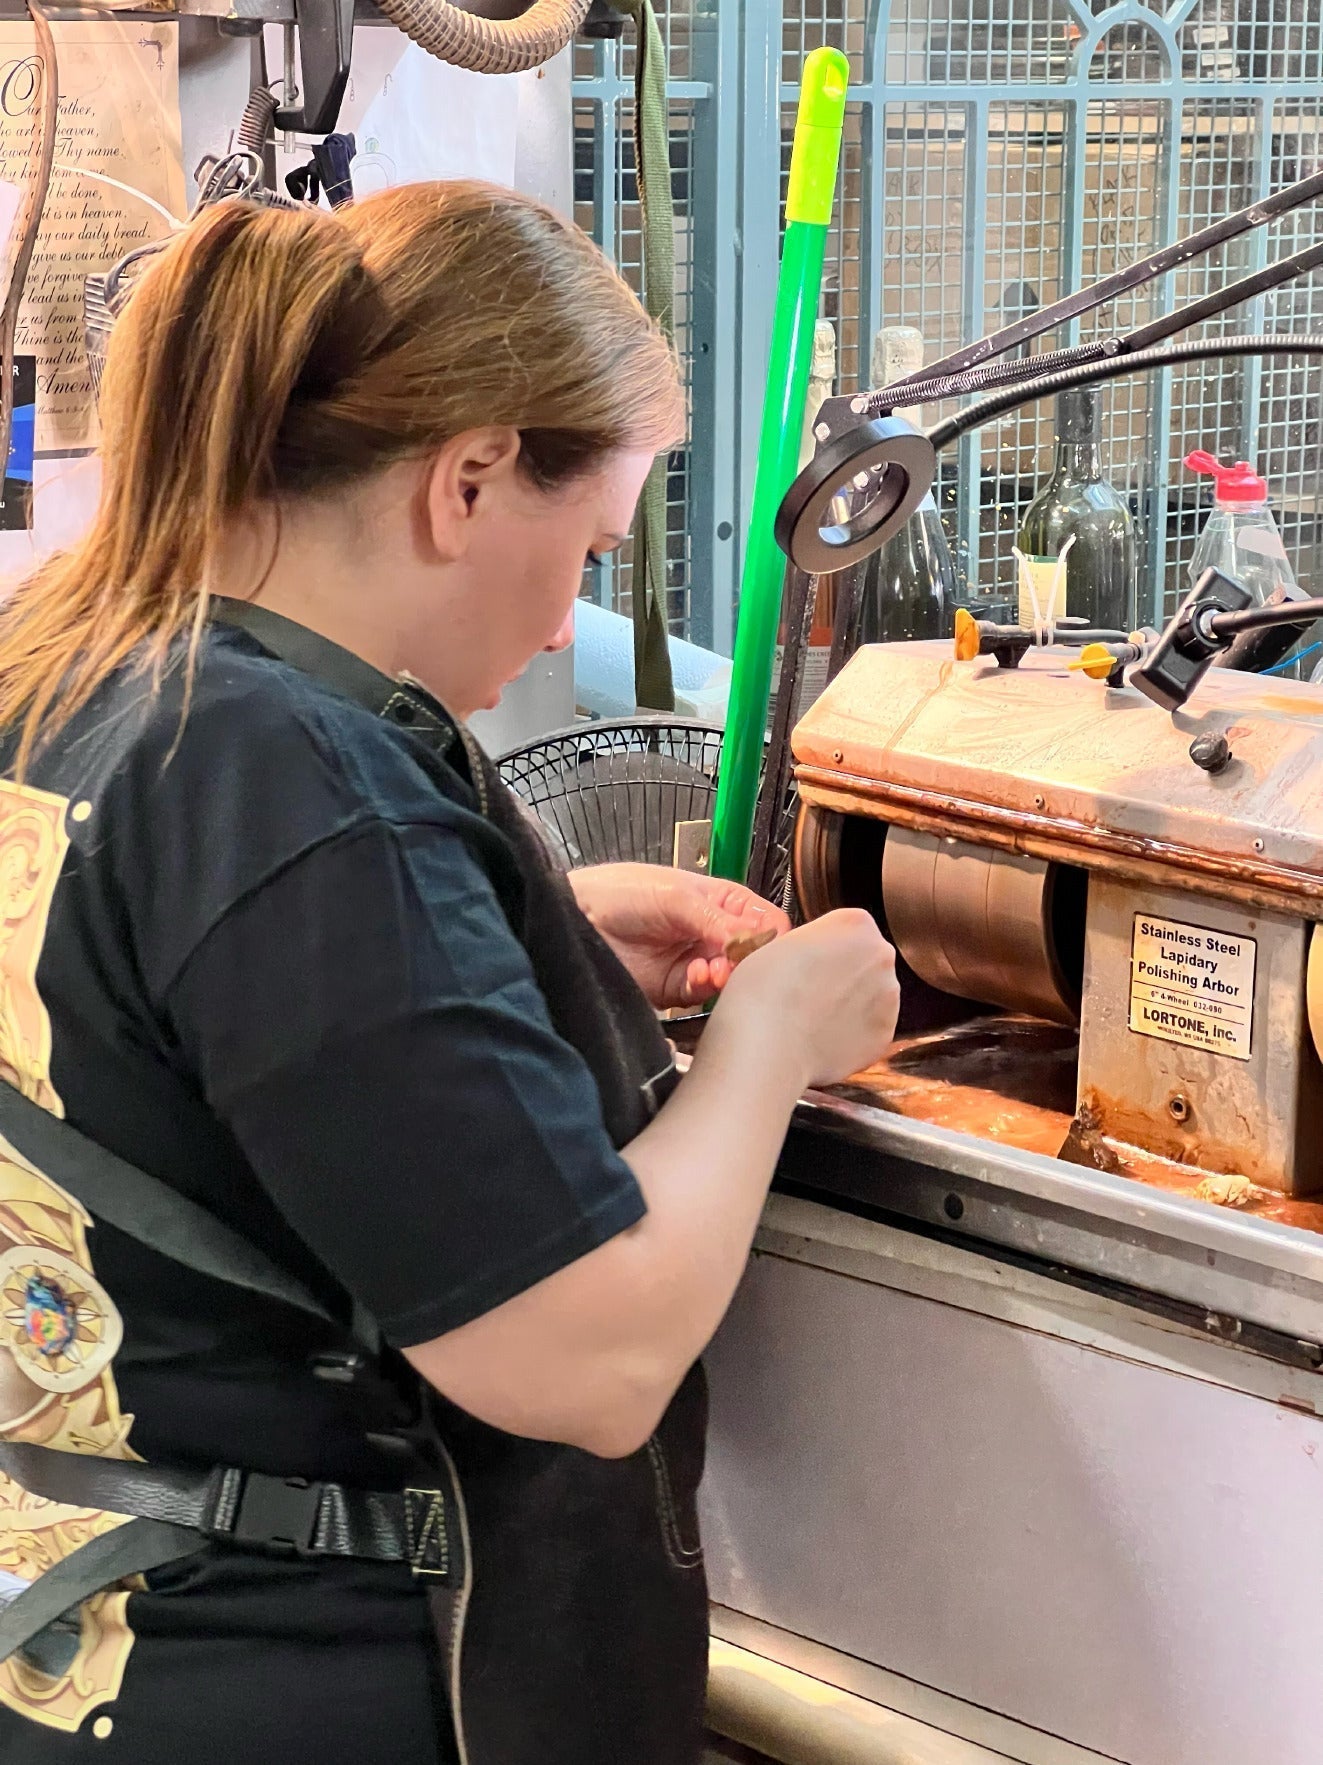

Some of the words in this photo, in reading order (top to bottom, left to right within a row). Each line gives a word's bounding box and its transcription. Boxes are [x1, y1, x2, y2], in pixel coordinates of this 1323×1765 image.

[0, 120, 12, 136] ho
[16, 123, 36, 137] art
[56, 120, 99, 138] heaven,
[0, 140, 34, 156] lowed
[54, 137, 83, 165] Thy
[0, 160, 17, 183] hy
[20, 162, 72, 179] kindom
[56, 183, 66, 199] be
[70, 182, 102, 201] done,
[54, 206, 62, 220] is
[65, 206, 77, 220] in
[81, 202, 127, 219] heaven.
[55, 232, 75, 241] our
[78, 222, 110, 247] daily
[113, 221, 151, 240] bread.
[31, 250, 56, 270] give
[60, 250, 71, 261] us
[75, 250, 95, 261] our
[28, 286, 55, 303] lead
[57, 293, 69, 303] us
[31, 314, 43, 325] us
[44, 306, 77, 331] from
[14, 326, 49, 345] Thine
[53, 331, 63, 344] is
[66, 326, 84, 344] the
[36, 347, 64, 365] and
[65, 346, 84, 364] the
[1140, 922, 1201, 948] Stainless
[1206, 937, 1241, 957] Steel
[1160, 946, 1218, 974] Lapidary
[1138, 961, 1198, 989] Polishing
[1202, 976, 1240, 996] Arbor
[1143, 1006, 1209, 1037] LORTONE,
